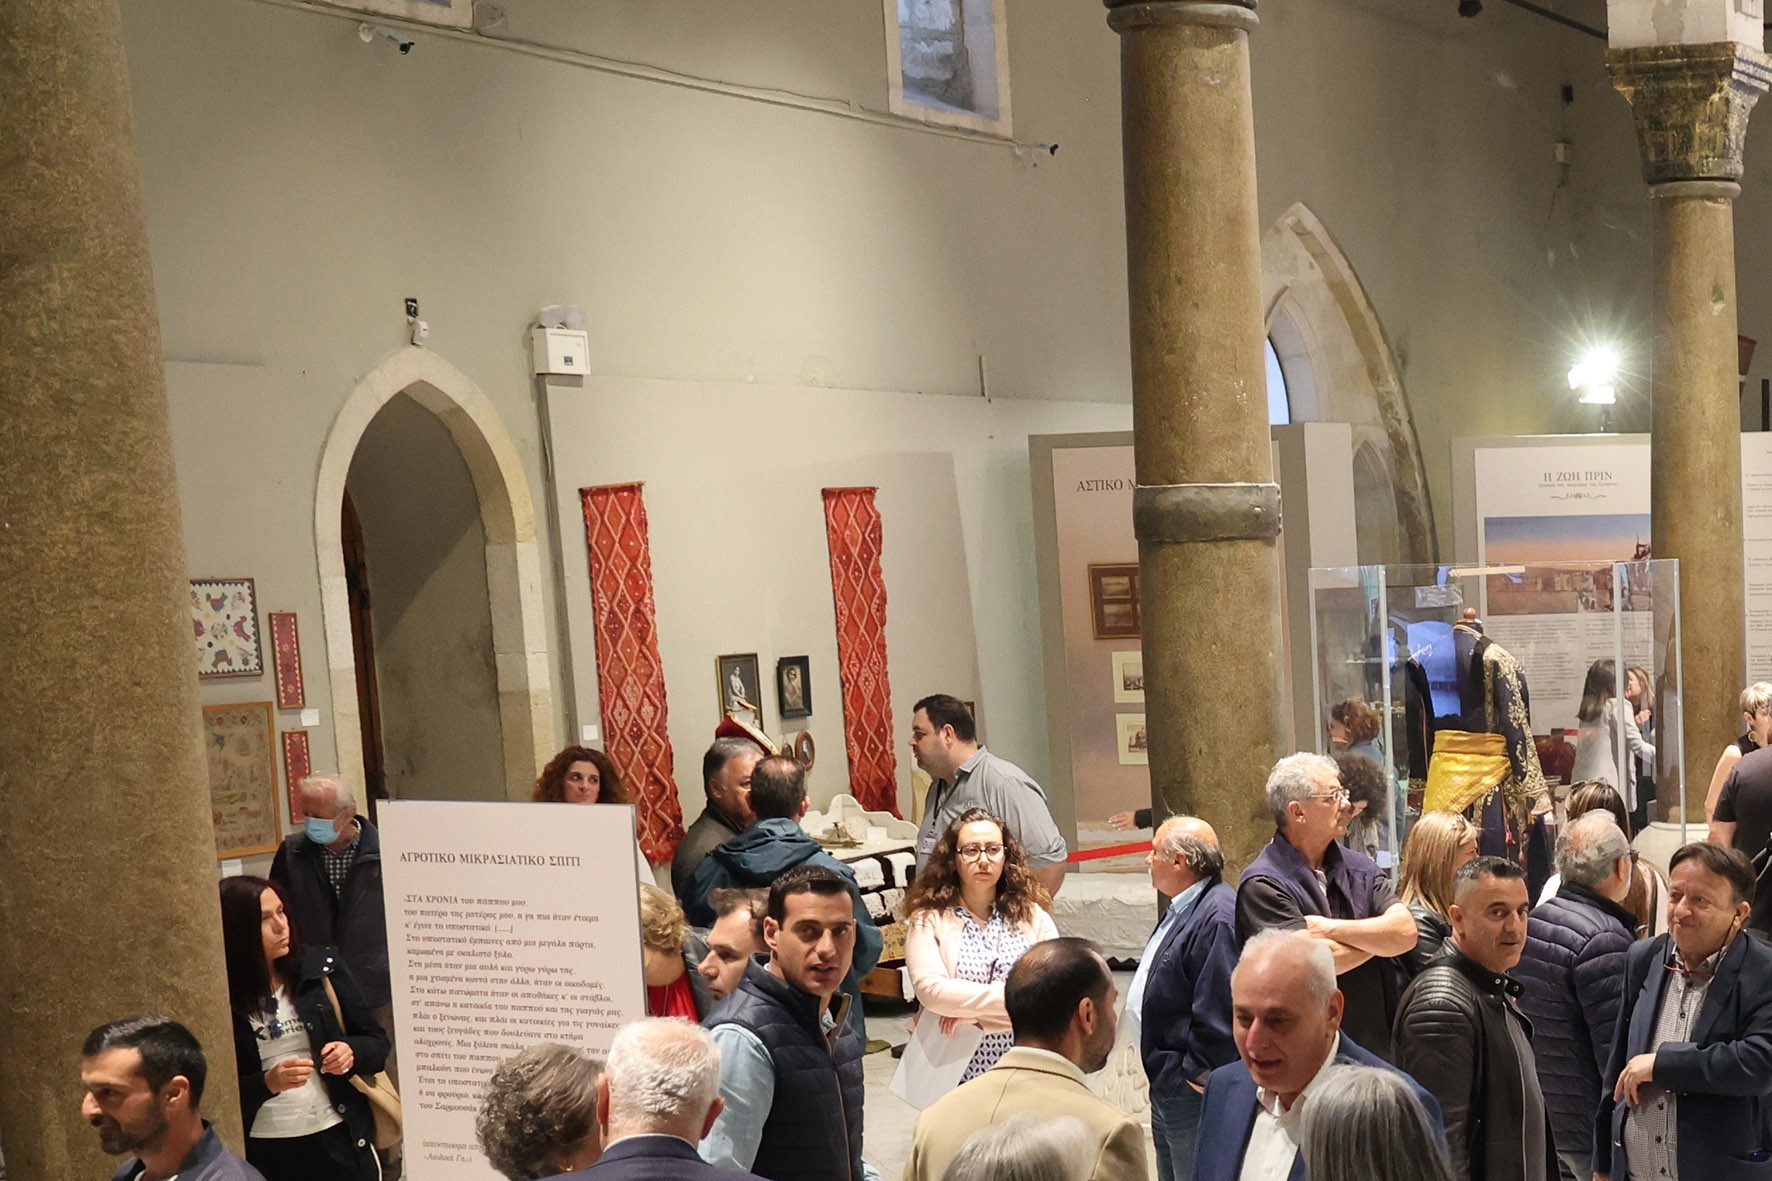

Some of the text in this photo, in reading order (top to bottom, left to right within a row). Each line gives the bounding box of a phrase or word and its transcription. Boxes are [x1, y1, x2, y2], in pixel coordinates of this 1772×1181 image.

[1556, 471, 1580, 481] ΖΩΗ
[1584, 471, 1613, 481] ΠΡΙΝ
[1076, 479, 1123, 492] ΑΣΤΙΚΟ
[400, 852, 580, 866] ΑΓΡΟΤΙΚΟ ΜΙΚΡΑΣΙΑΤΙΚΟ ΣΠΙΤΙ
[425, 895, 458, 904] ΧΡΟΝΙΑ
